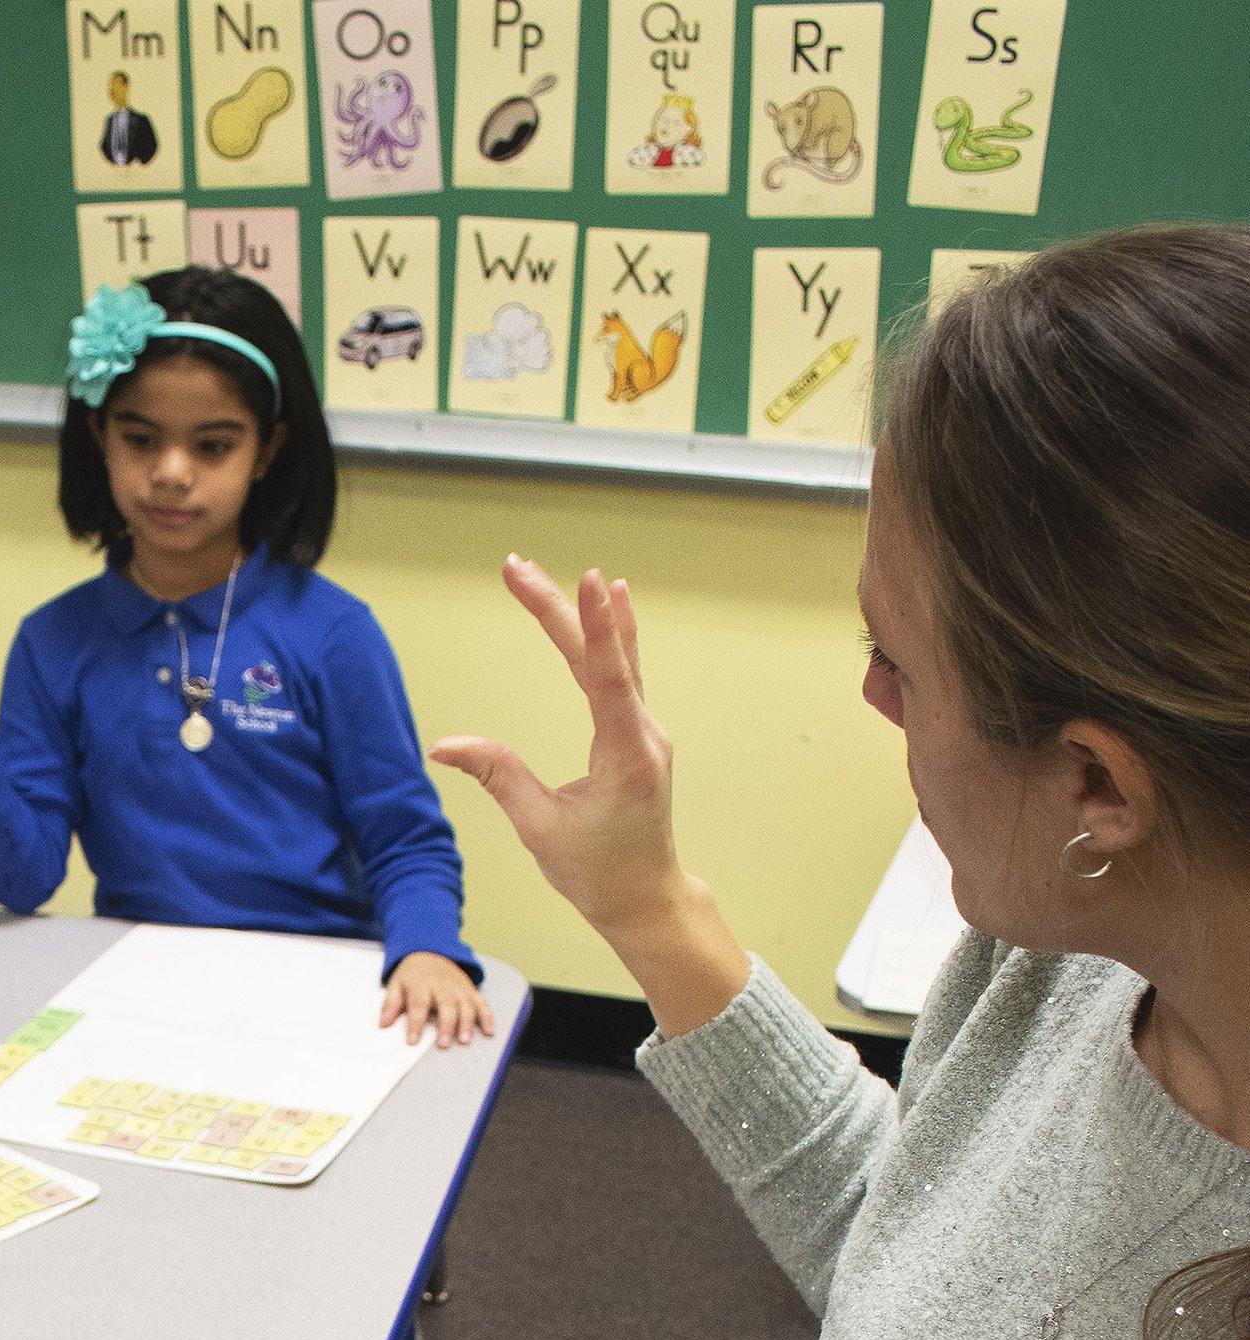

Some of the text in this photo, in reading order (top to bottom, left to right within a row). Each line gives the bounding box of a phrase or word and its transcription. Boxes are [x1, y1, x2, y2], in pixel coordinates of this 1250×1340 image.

[82, 8, 165, 59] Mm
[214, 2, 279, 54] Nn
[336, 8, 411, 61] Oo
[492, 0, 545, 75] Pp
[640, 2, 701, 44] Qu
[792, 20, 845, 74] Rr
[966, 8, 1019, 65] Ss
[649, 45, 690, 90] qu
[105, 214, 153, 263] Tt
[214, 220, 271, 269] Uu
[352, 229, 408, 280] Vv
[474, 230, 556, 283] Ww
[611, 242, 674, 297] Xx
[787, 260, 843, 339] Yy
